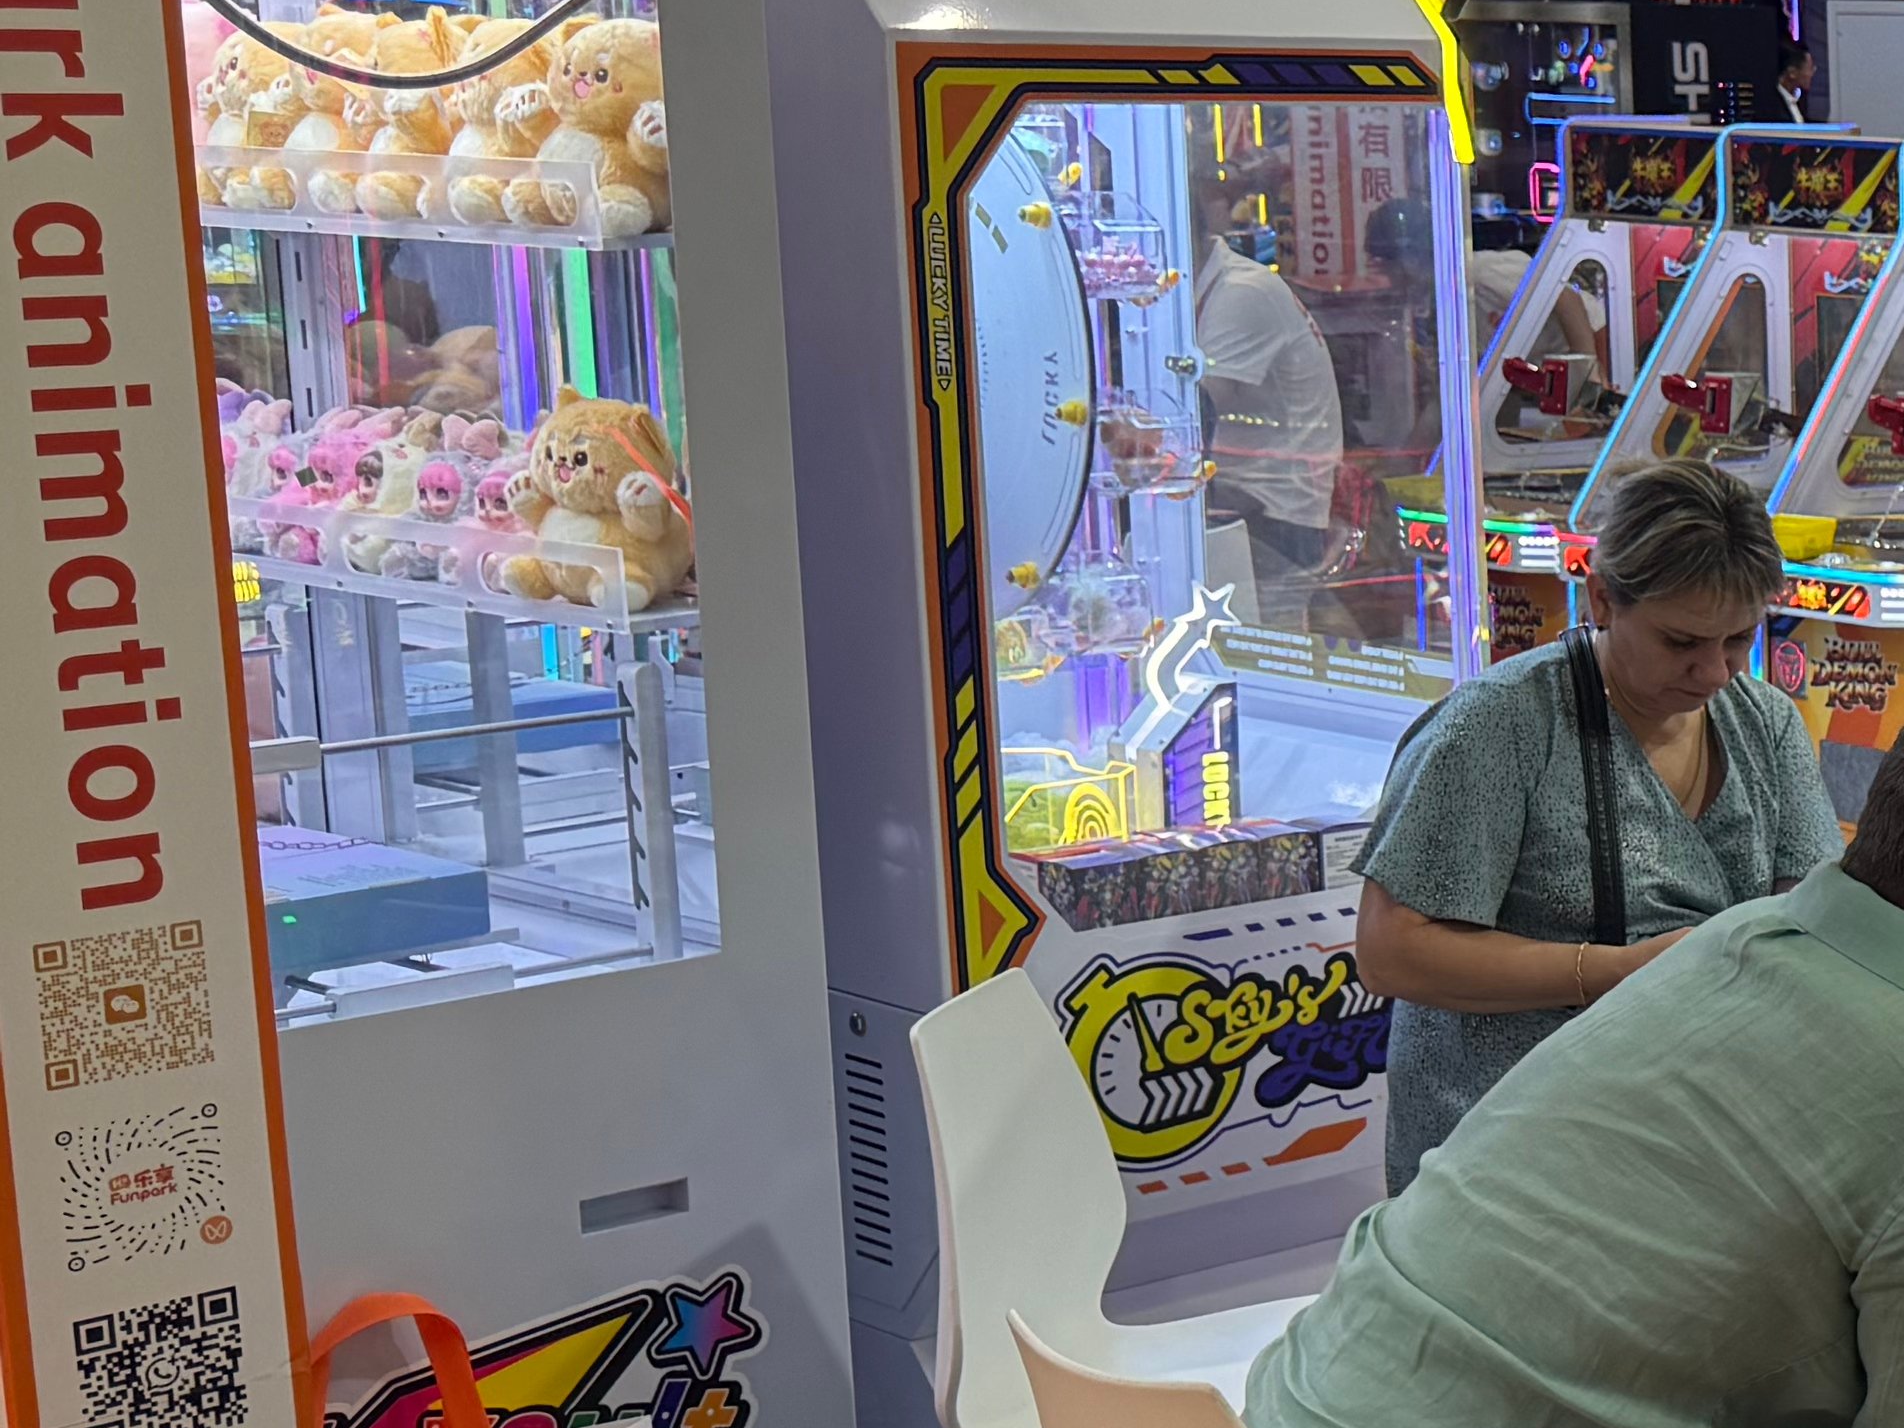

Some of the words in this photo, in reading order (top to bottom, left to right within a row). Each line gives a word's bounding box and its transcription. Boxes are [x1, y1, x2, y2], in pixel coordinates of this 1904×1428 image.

[928, 224, 952, 316] LUCKY
[936, 317, 954, 380] TIME
[15, 191, 184, 911] animation
[1810, 657, 1899, 687] DEMON
[1822, 636, 1883, 662] BULL
[1827, 677, 1887, 714] KING
[1166, 956, 1358, 1068] Sky's
[110, 1182, 178, 1206] Funpark
